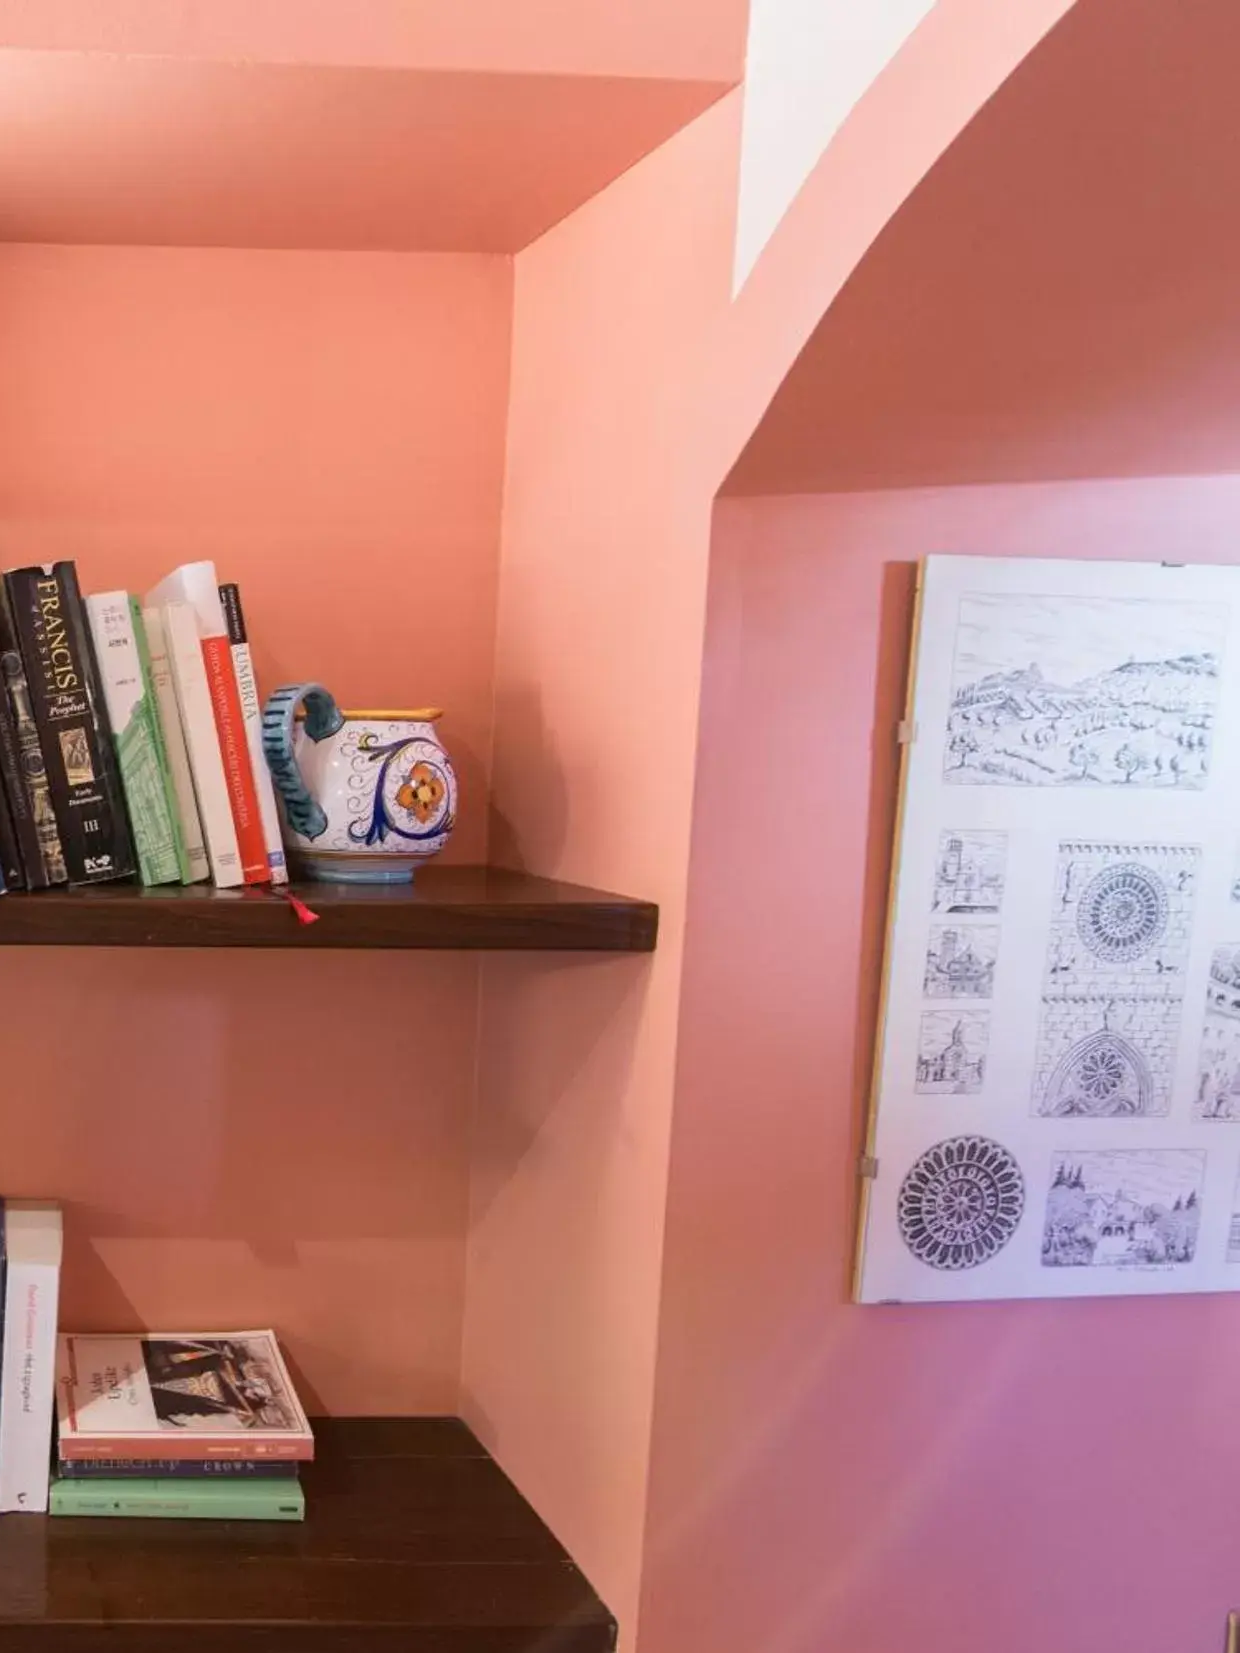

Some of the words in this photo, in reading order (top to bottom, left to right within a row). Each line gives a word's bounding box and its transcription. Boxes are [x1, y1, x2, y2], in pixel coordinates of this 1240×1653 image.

[37, 579, 78, 688] FRANCIS
[58, 695, 75, 705] The
[235, 650, 257, 720] UMBRIA
[49, 702, 86, 717] Prophet
